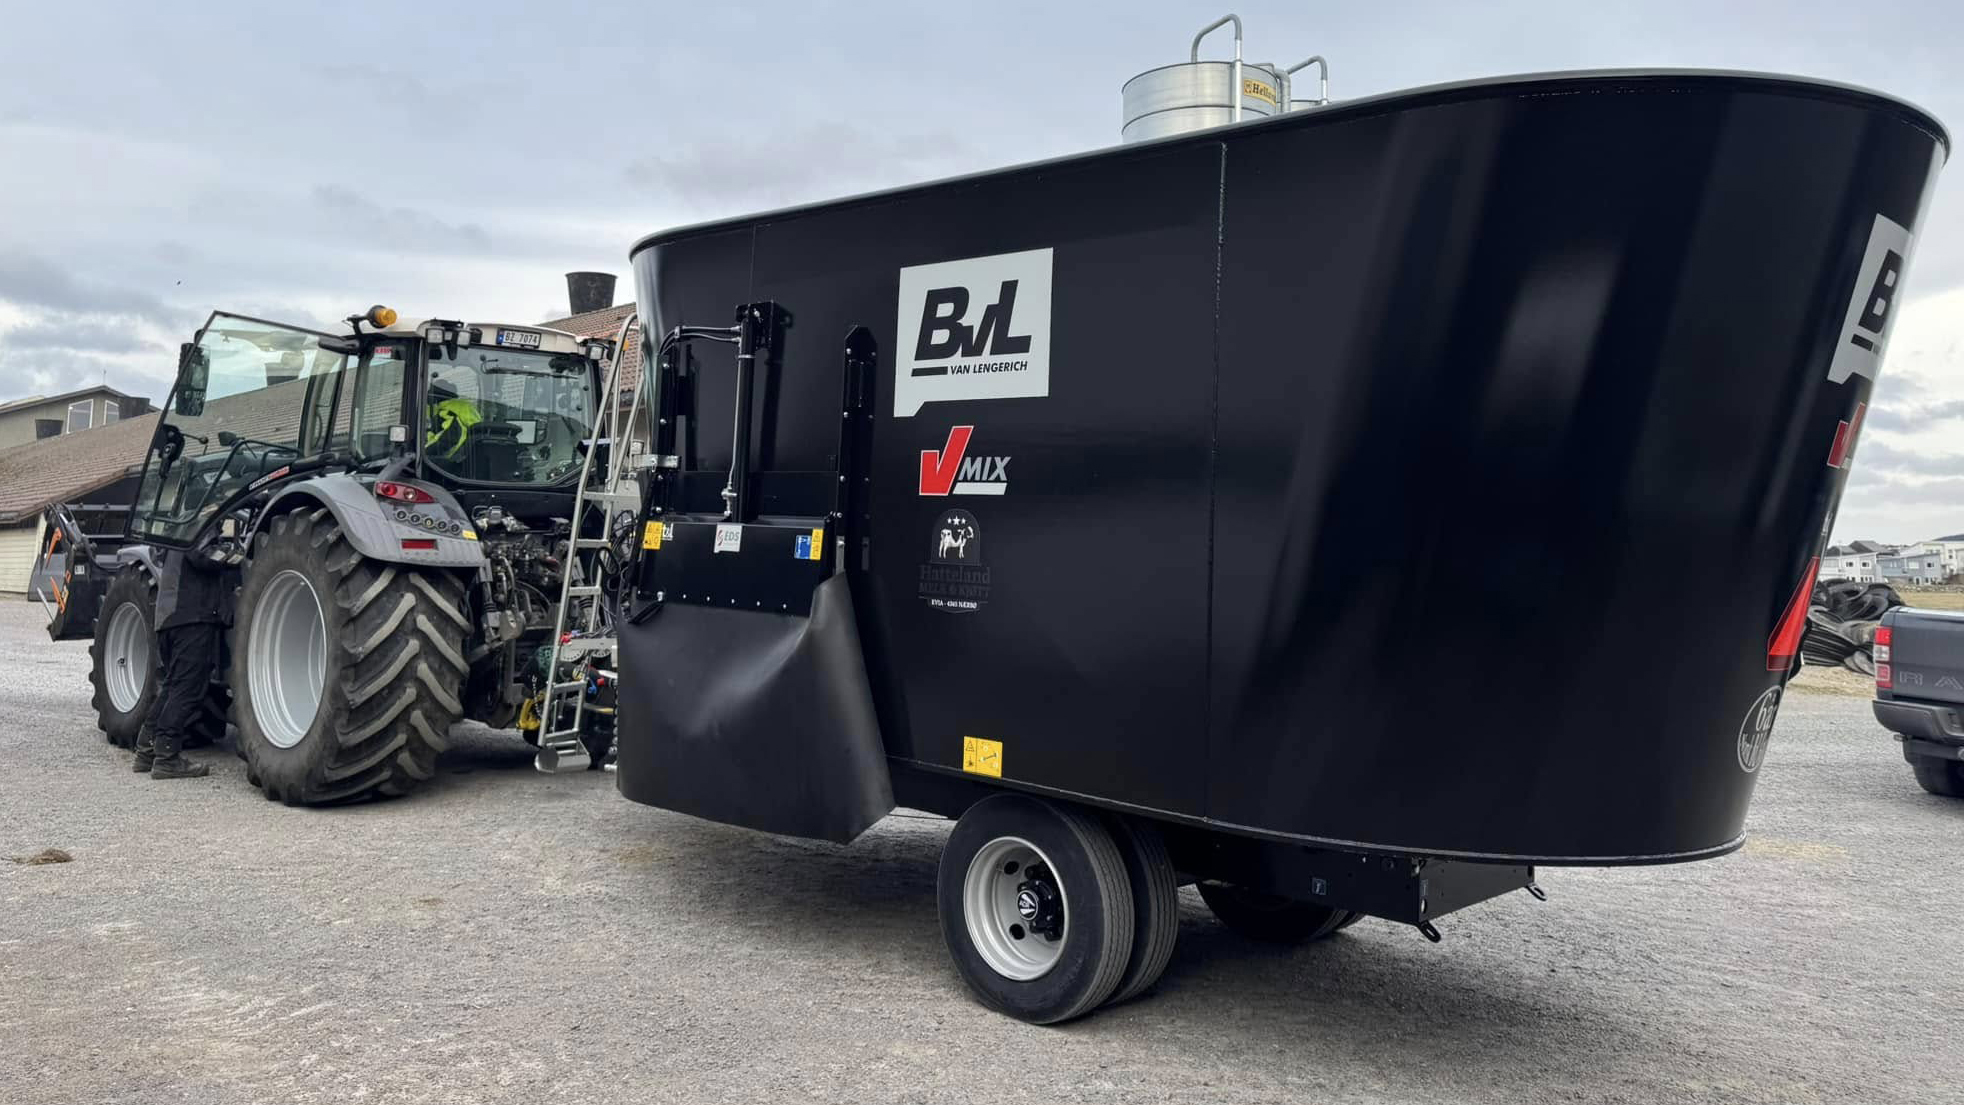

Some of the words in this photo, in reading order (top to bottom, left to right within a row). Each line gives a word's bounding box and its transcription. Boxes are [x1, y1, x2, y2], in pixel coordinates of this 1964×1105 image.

[519, 333, 539, 344] 7074
[950, 364, 970, 375] VAN
[973, 360, 1028, 374] LENGERICH
[724, 531, 740, 542] EDS
